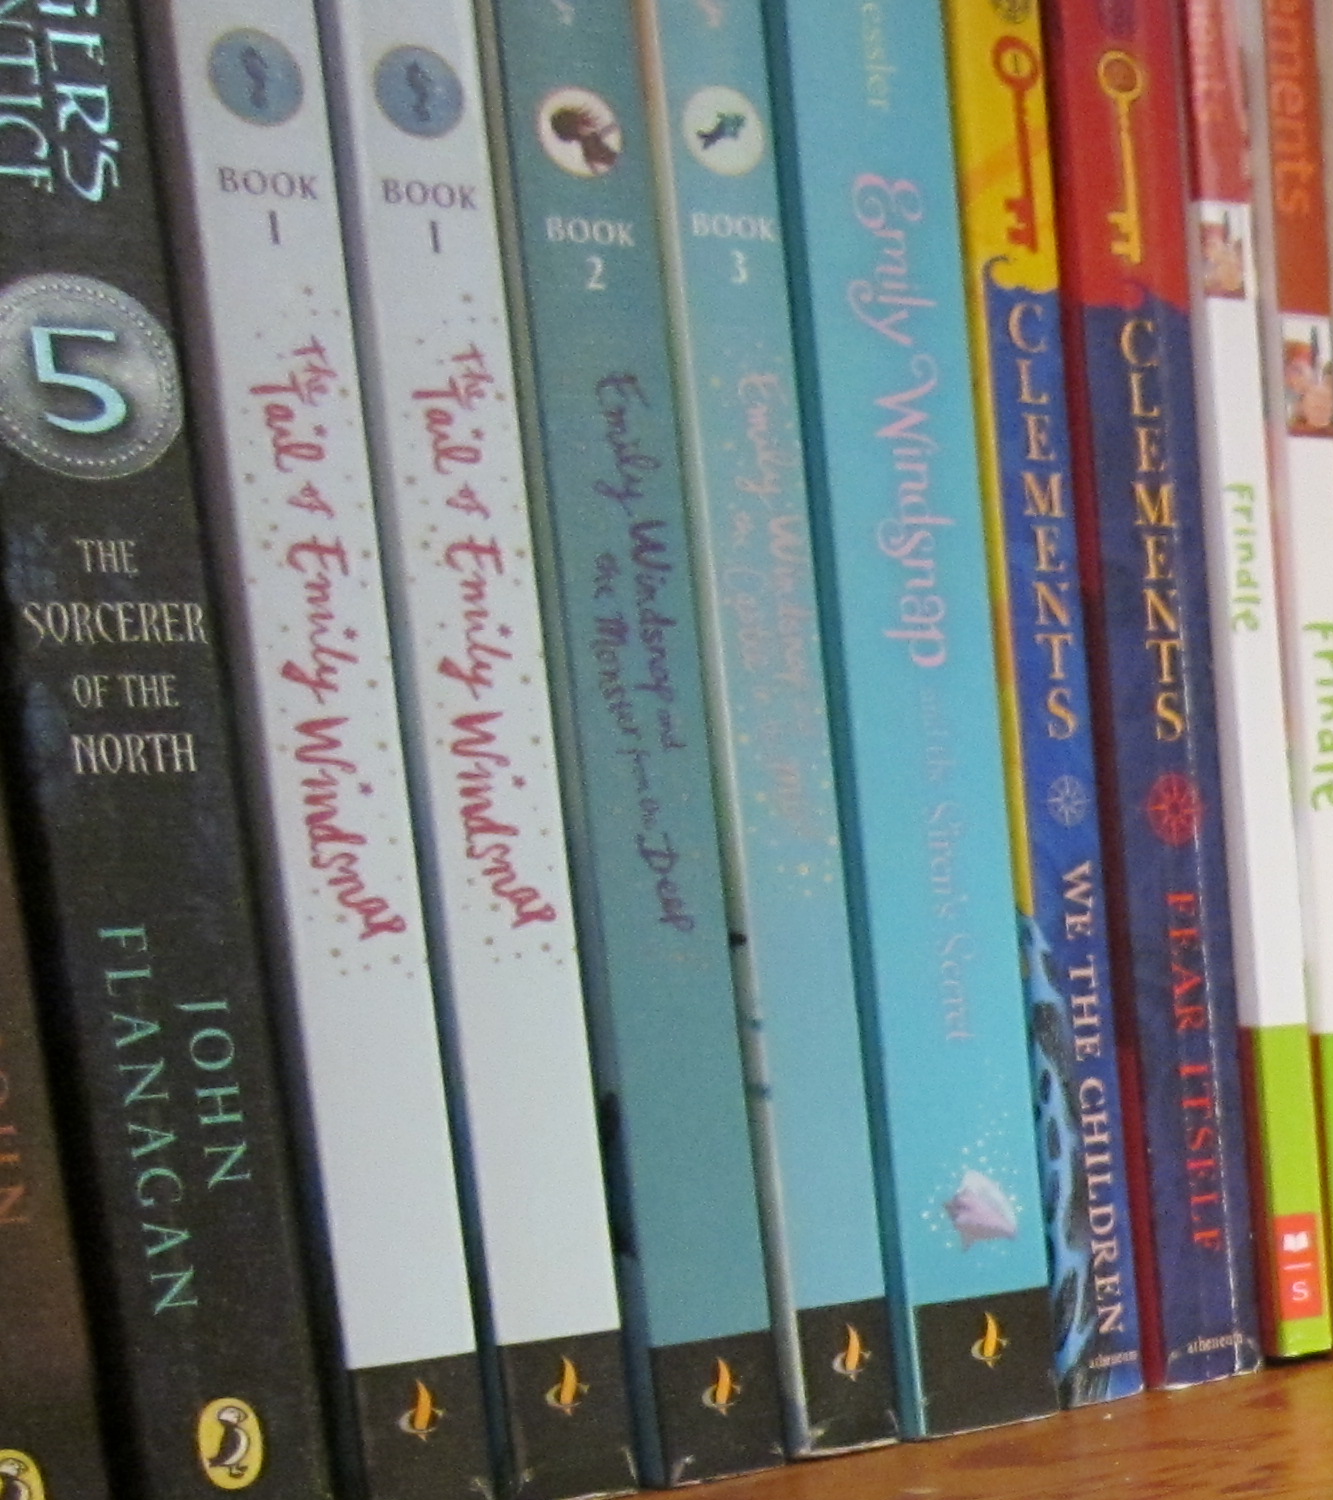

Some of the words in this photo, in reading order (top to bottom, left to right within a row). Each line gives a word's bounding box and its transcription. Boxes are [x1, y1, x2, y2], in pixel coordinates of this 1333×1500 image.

[217, 166, 319, 201] BOOK
[381, 177, 478, 211] BOOK
[547, 214, 635, 246] BOOK
[692, 211, 774, 244] BOOK
[586, 257, 605, 291] 2
[731, 251, 747, 285] 3
[851, 170, 936, 348] Emily
[30, 326, 127, 434] 5
[250, 368, 328, 473] Tail
[411, 378, 482, 476] Tail
[287, 482, 336, 519] of
[446, 484, 490, 521] of
[876, 354, 956, 668] Windsnap
[1007, 303, 1081, 741] CLEMENTS
[1119, 318, 1187, 743] CLEMENTS
[76, 539, 139, 574] THE
[1224, 482, 1261, 633] frindle
[22, 602, 207, 643] SORCERER
[282, 536, 359, 706] Emily
[438, 535, 513, 700] Emily
[73, 674, 110, 709] OF
[118, 674, 180, 708] THE
[71, 732, 198, 775] NORTH
[296, 716, 407, 940] Windsnap
[449, 712, 558, 929] Windsnap
[1061, 862, 1094, 942] WE
[1068, 955, 1101, 1065] THE
[1165, 890, 1202, 1036] FEAR
[99, 925, 199, 1316] FLANAGAN
[176, 1000, 251, 1191] JOHN
[1078, 1076, 1125, 1336] CHILDREN
[1179, 1061, 1223, 1253] ITSELF
